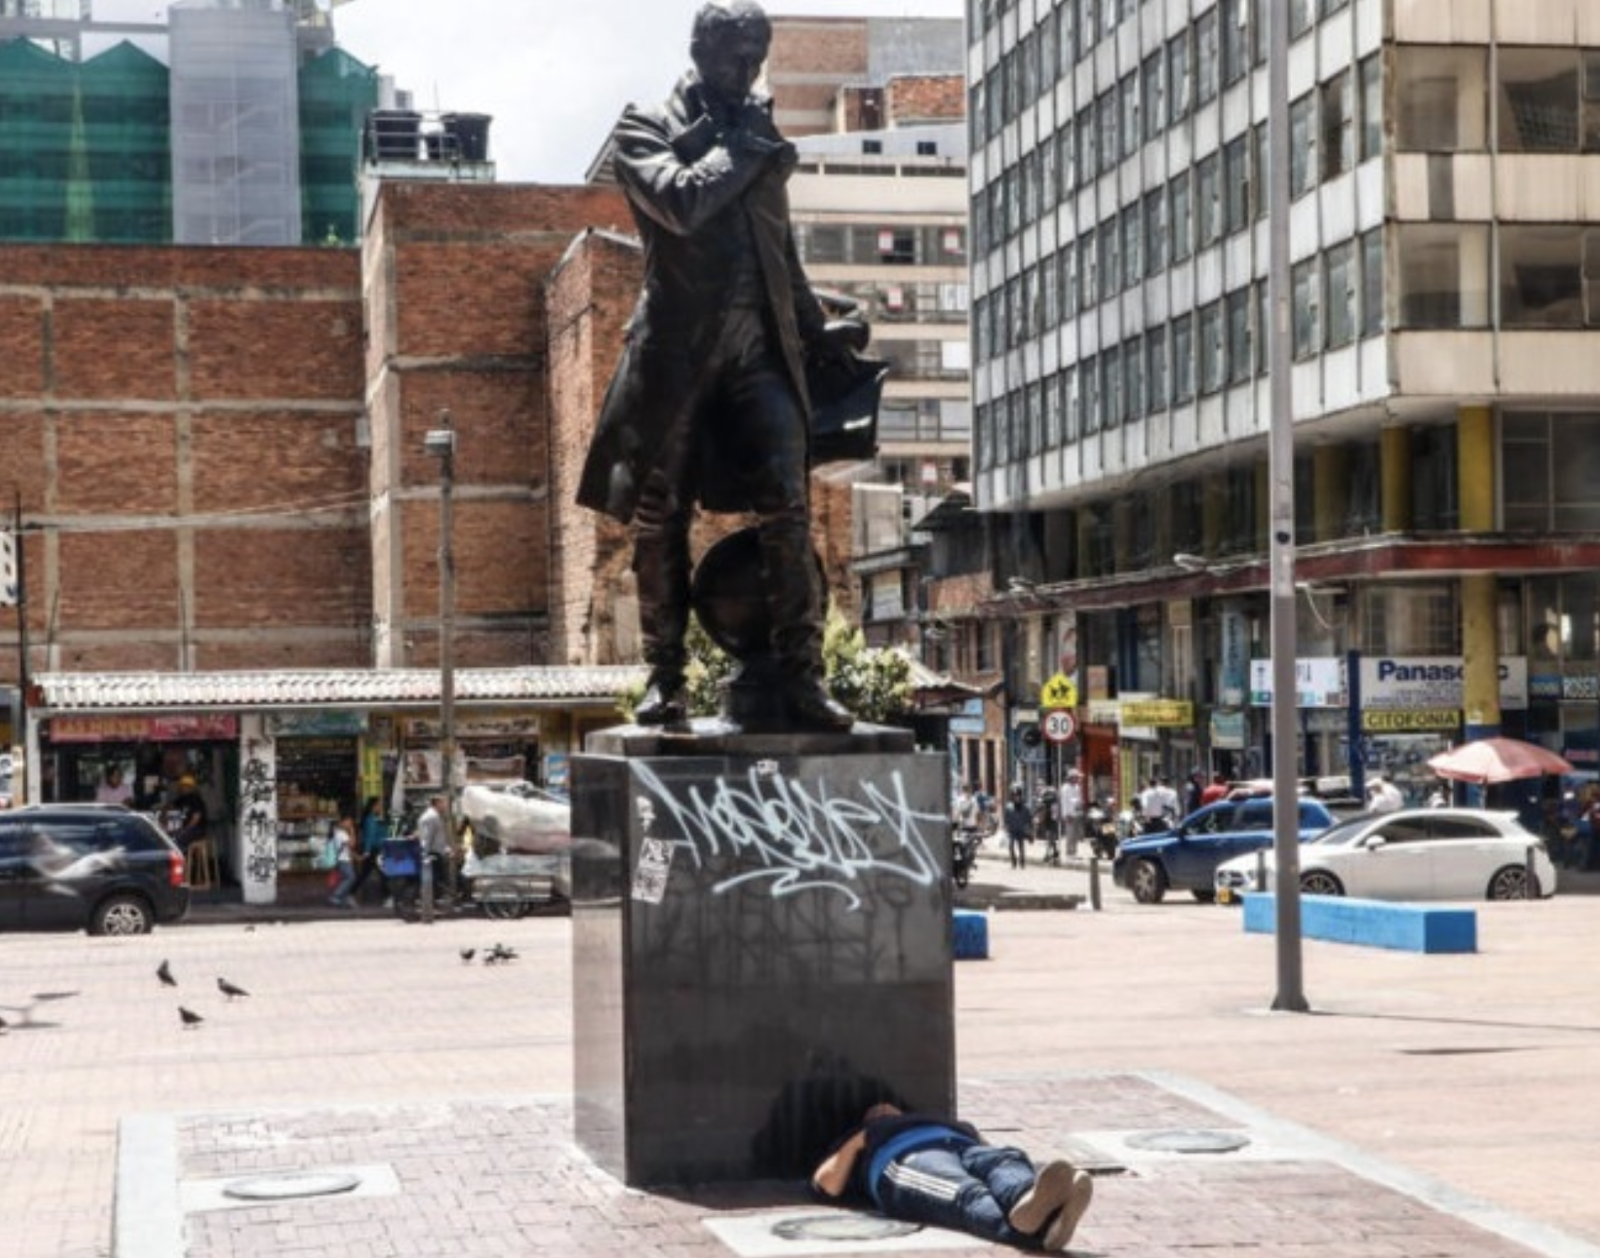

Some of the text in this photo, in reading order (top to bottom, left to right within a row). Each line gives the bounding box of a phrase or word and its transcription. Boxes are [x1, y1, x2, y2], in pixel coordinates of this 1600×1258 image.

[1377, 660, 1509, 681] Panasc
[1049, 716, 1070, 735] 30
[1368, 711, 1457, 726] CITOFONIA
